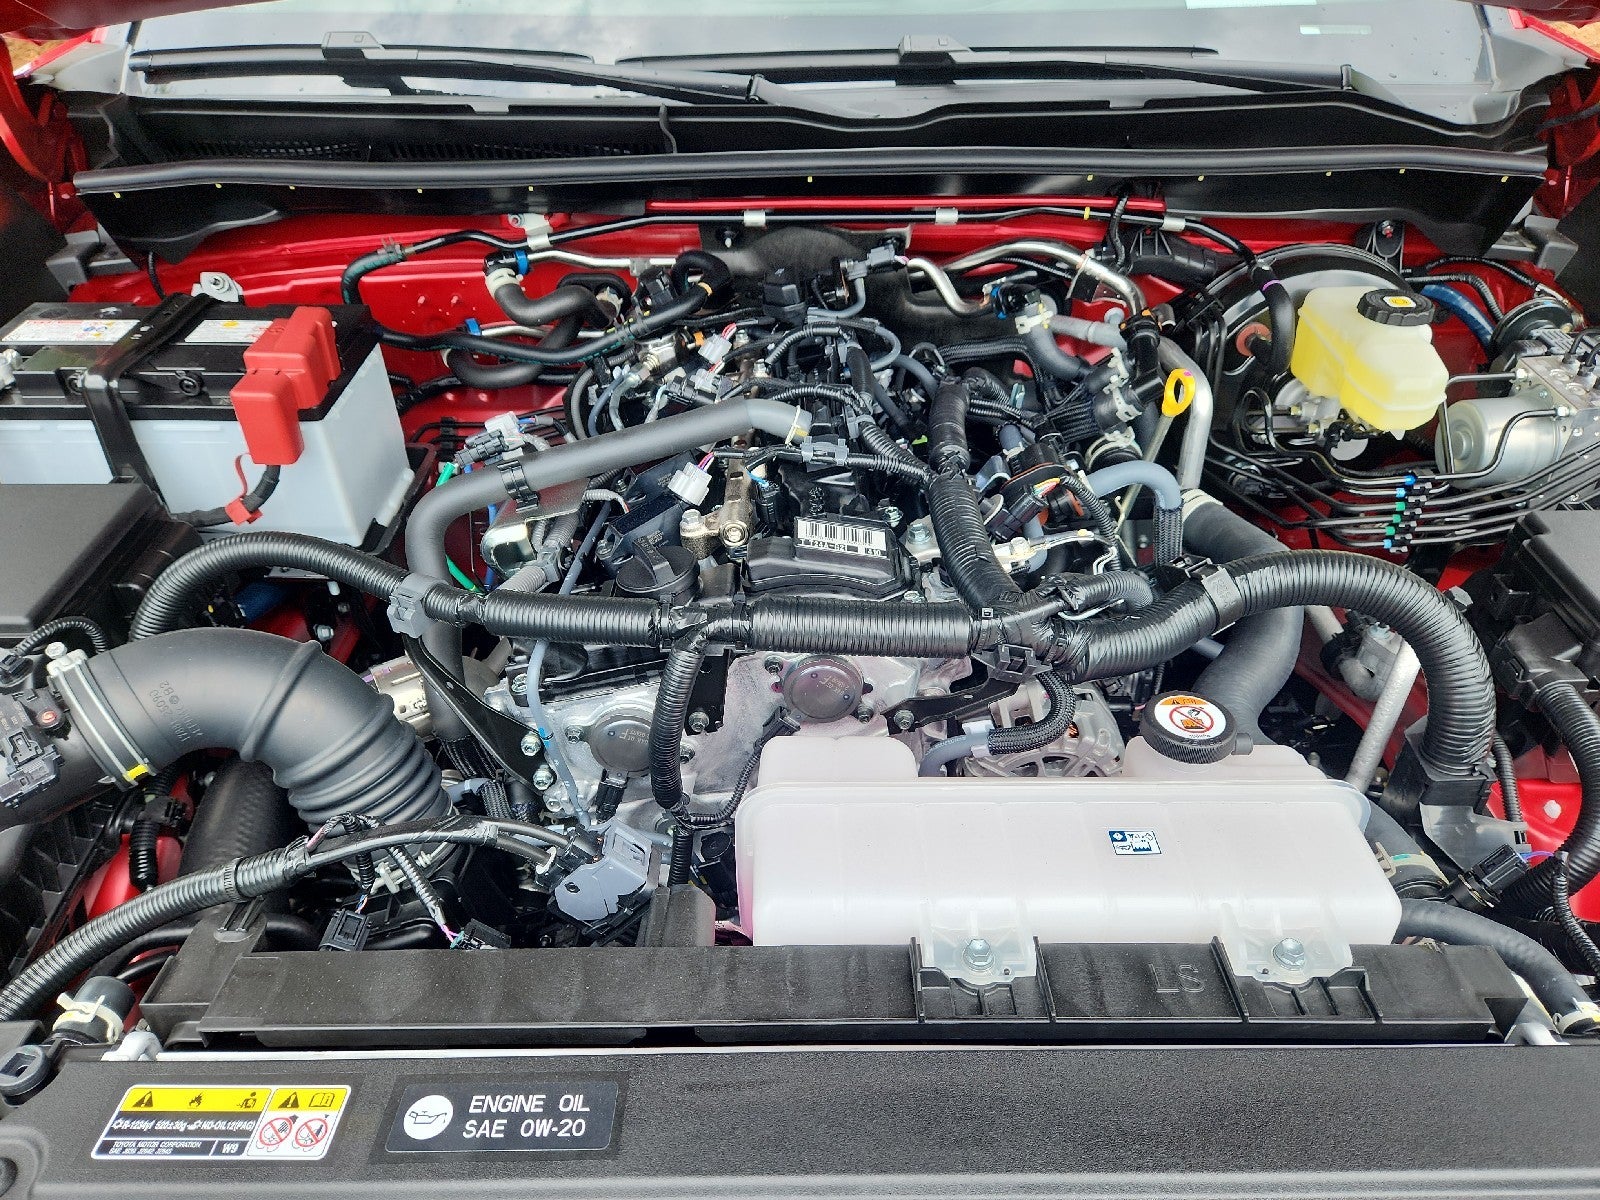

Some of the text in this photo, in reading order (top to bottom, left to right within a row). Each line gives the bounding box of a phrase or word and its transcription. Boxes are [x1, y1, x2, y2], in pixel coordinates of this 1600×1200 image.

[1148, 964, 1204, 992] LS
[468, 1094, 590, 1113] ENGINE OIL
[463, 1118, 586, 1138] SAE 0W-20
[222, 1142, 240, 1154] W9
